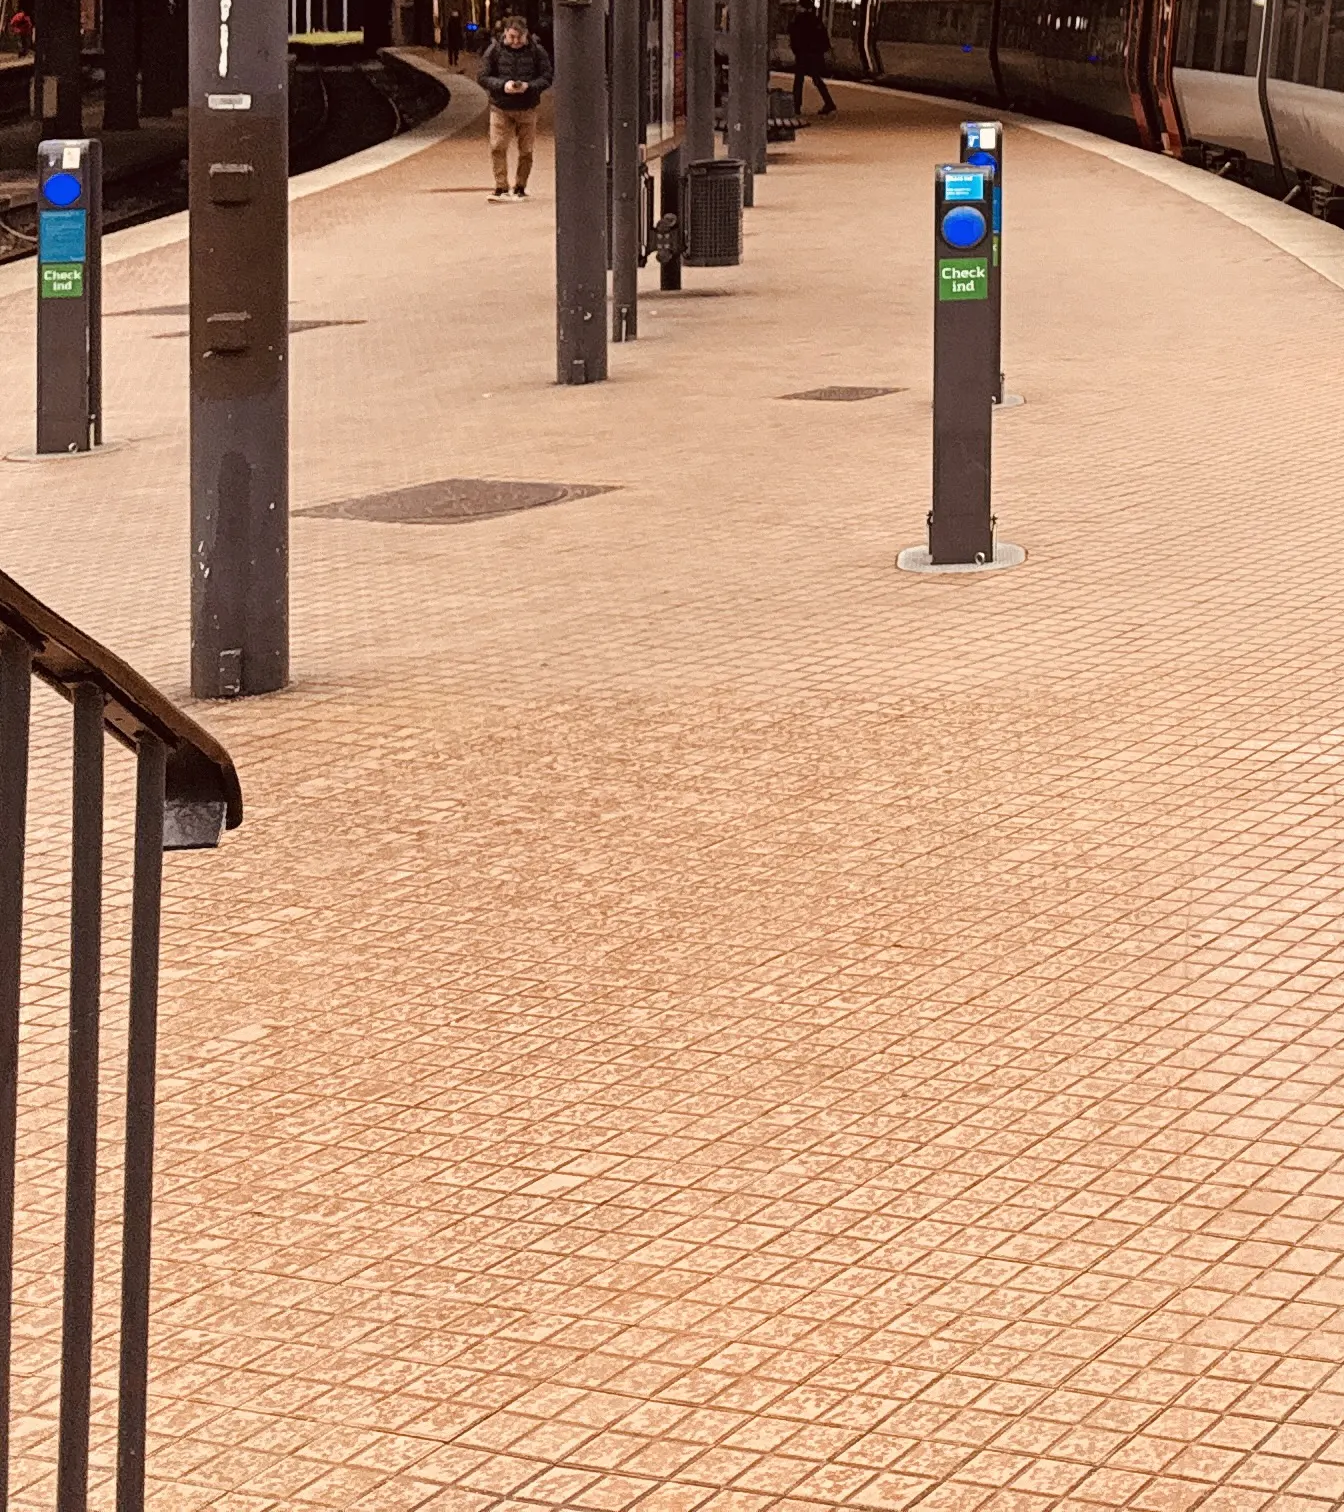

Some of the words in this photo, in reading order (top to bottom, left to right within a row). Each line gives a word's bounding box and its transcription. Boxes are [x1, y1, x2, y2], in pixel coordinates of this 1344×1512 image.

[44, 269, 81, 281] Check
[942, 266, 985, 280] Check
[53, 281, 72, 292] ind
[952, 280, 975, 292] ind
